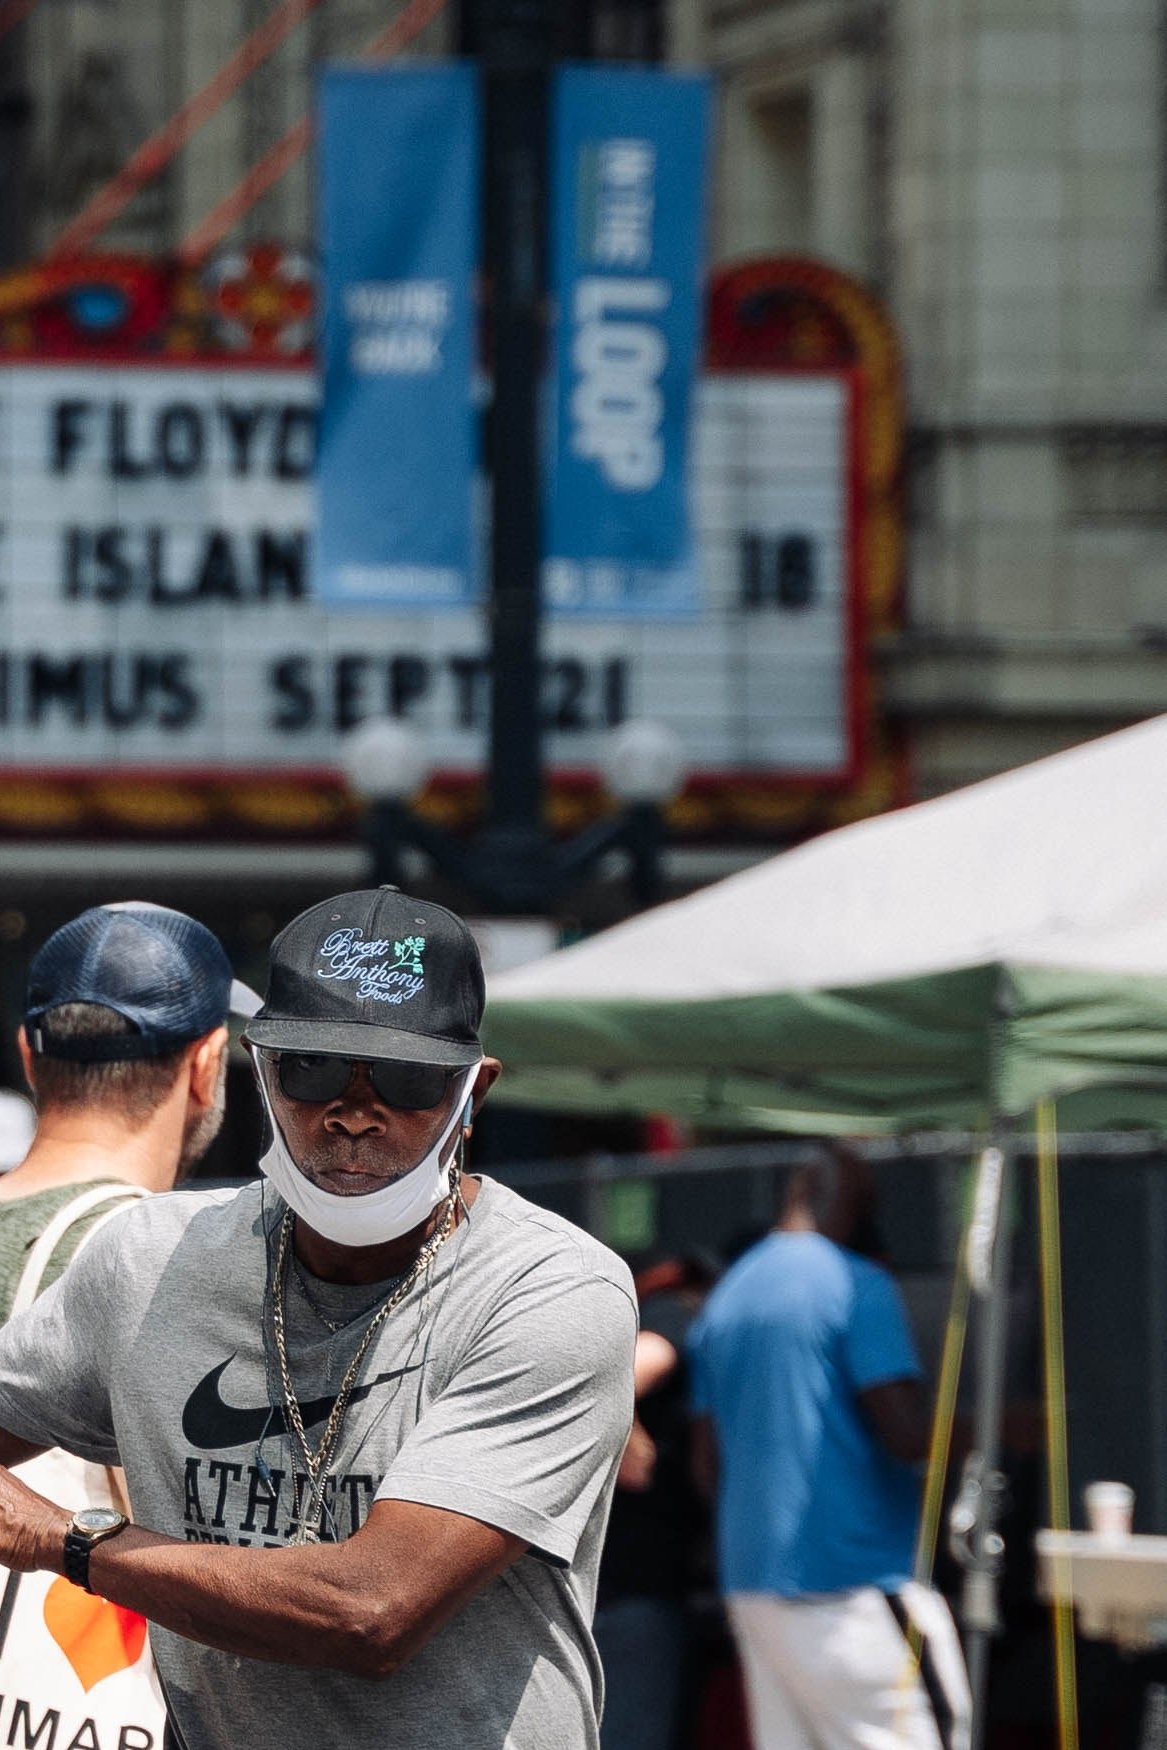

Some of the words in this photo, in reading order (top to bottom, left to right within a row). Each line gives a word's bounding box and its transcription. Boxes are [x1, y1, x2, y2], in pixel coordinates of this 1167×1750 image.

[572, 275, 671, 491] LOOP
[268, 650, 491, 737] SEPT
[320, 927, 390, 957] Brett
[317, 949, 424, 1000] Anthony
[355, 980, 404, 1005] Foods
